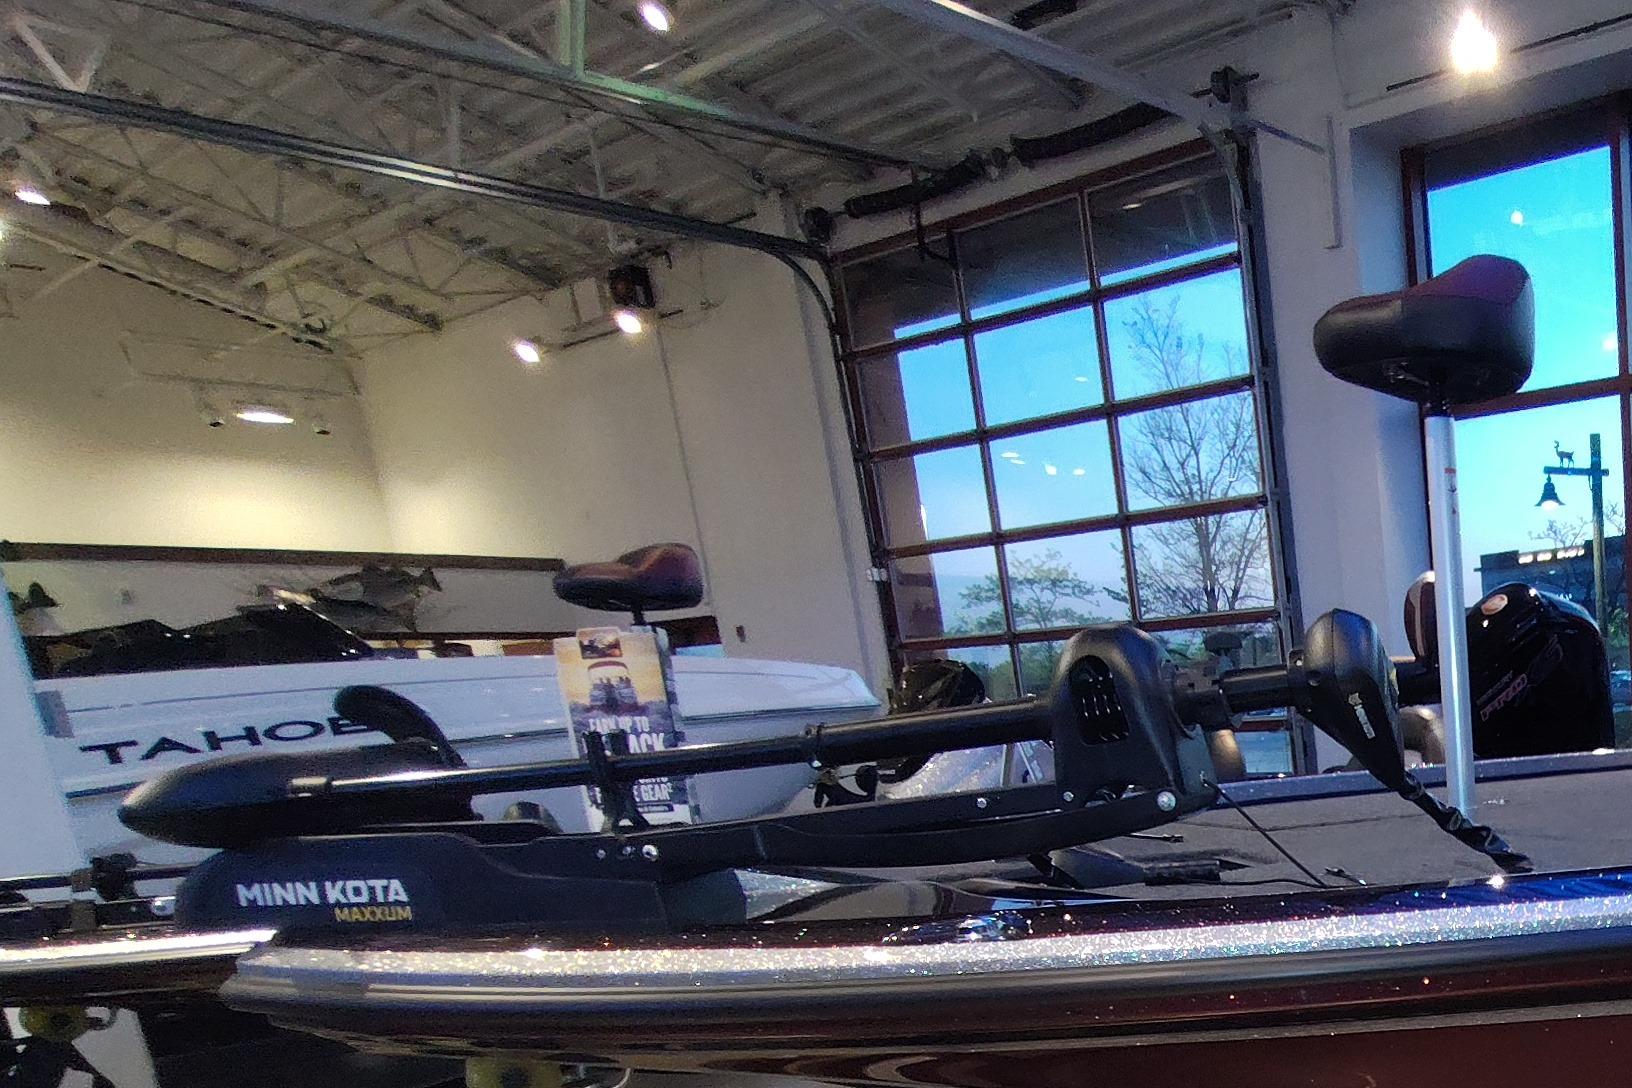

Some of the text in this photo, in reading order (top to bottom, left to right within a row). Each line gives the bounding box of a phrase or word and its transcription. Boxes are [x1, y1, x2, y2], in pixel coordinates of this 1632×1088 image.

[632, 715, 650, 732] TO
[628, 732, 666, 754] ACK
[236, 879, 410, 907] MINN KOTA
[334, 906, 413, 922] MAXXUM
